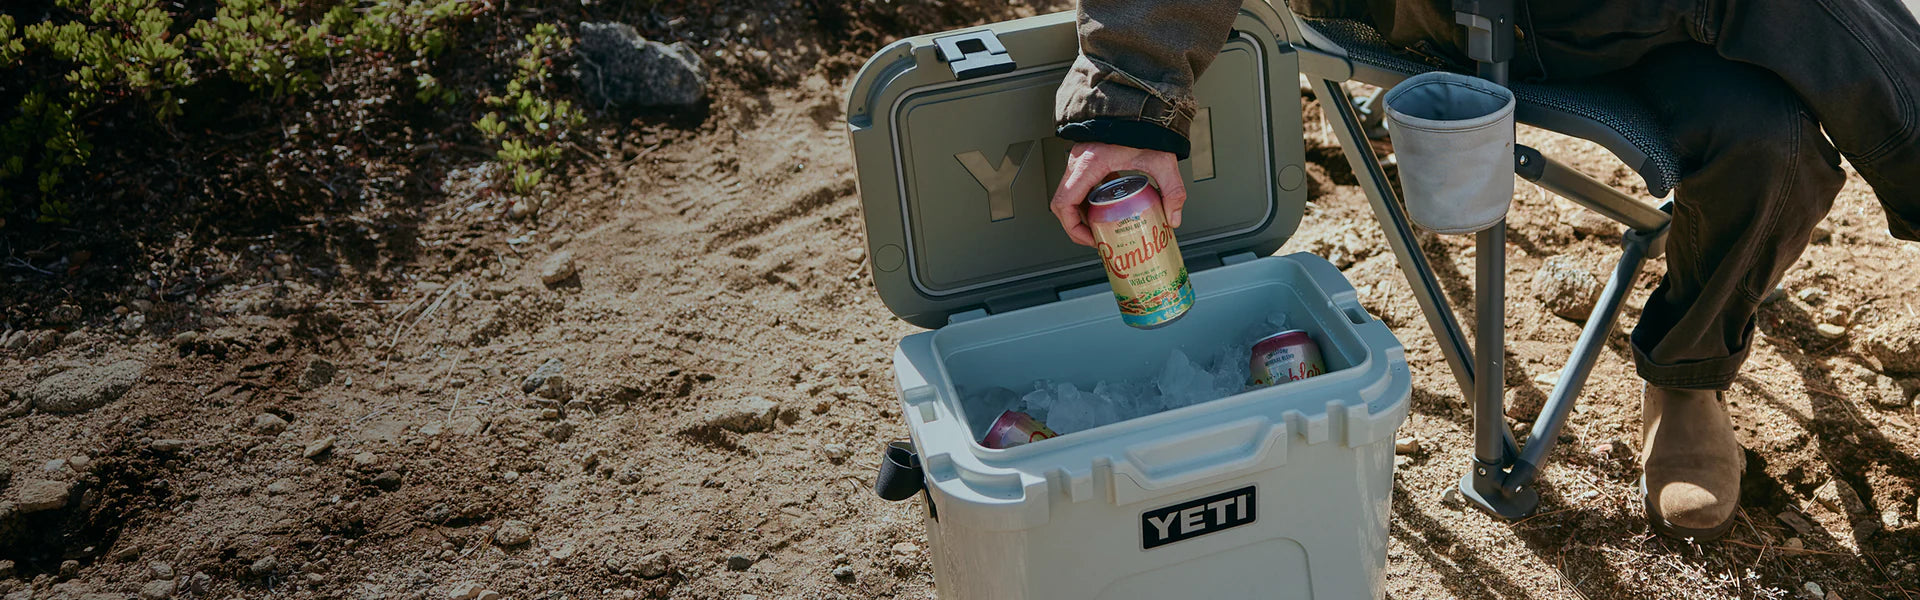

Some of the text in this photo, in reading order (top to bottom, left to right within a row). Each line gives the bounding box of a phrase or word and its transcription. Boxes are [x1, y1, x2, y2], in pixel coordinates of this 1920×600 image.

[953, 106, 1216, 222] YI
[1097, 222, 1173, 279] Rambler
[1129, 277, 1144, 286] Wild
[1145, 269, 1168, 283] Cherry
[1147, 494, 1247, 540] YETI
